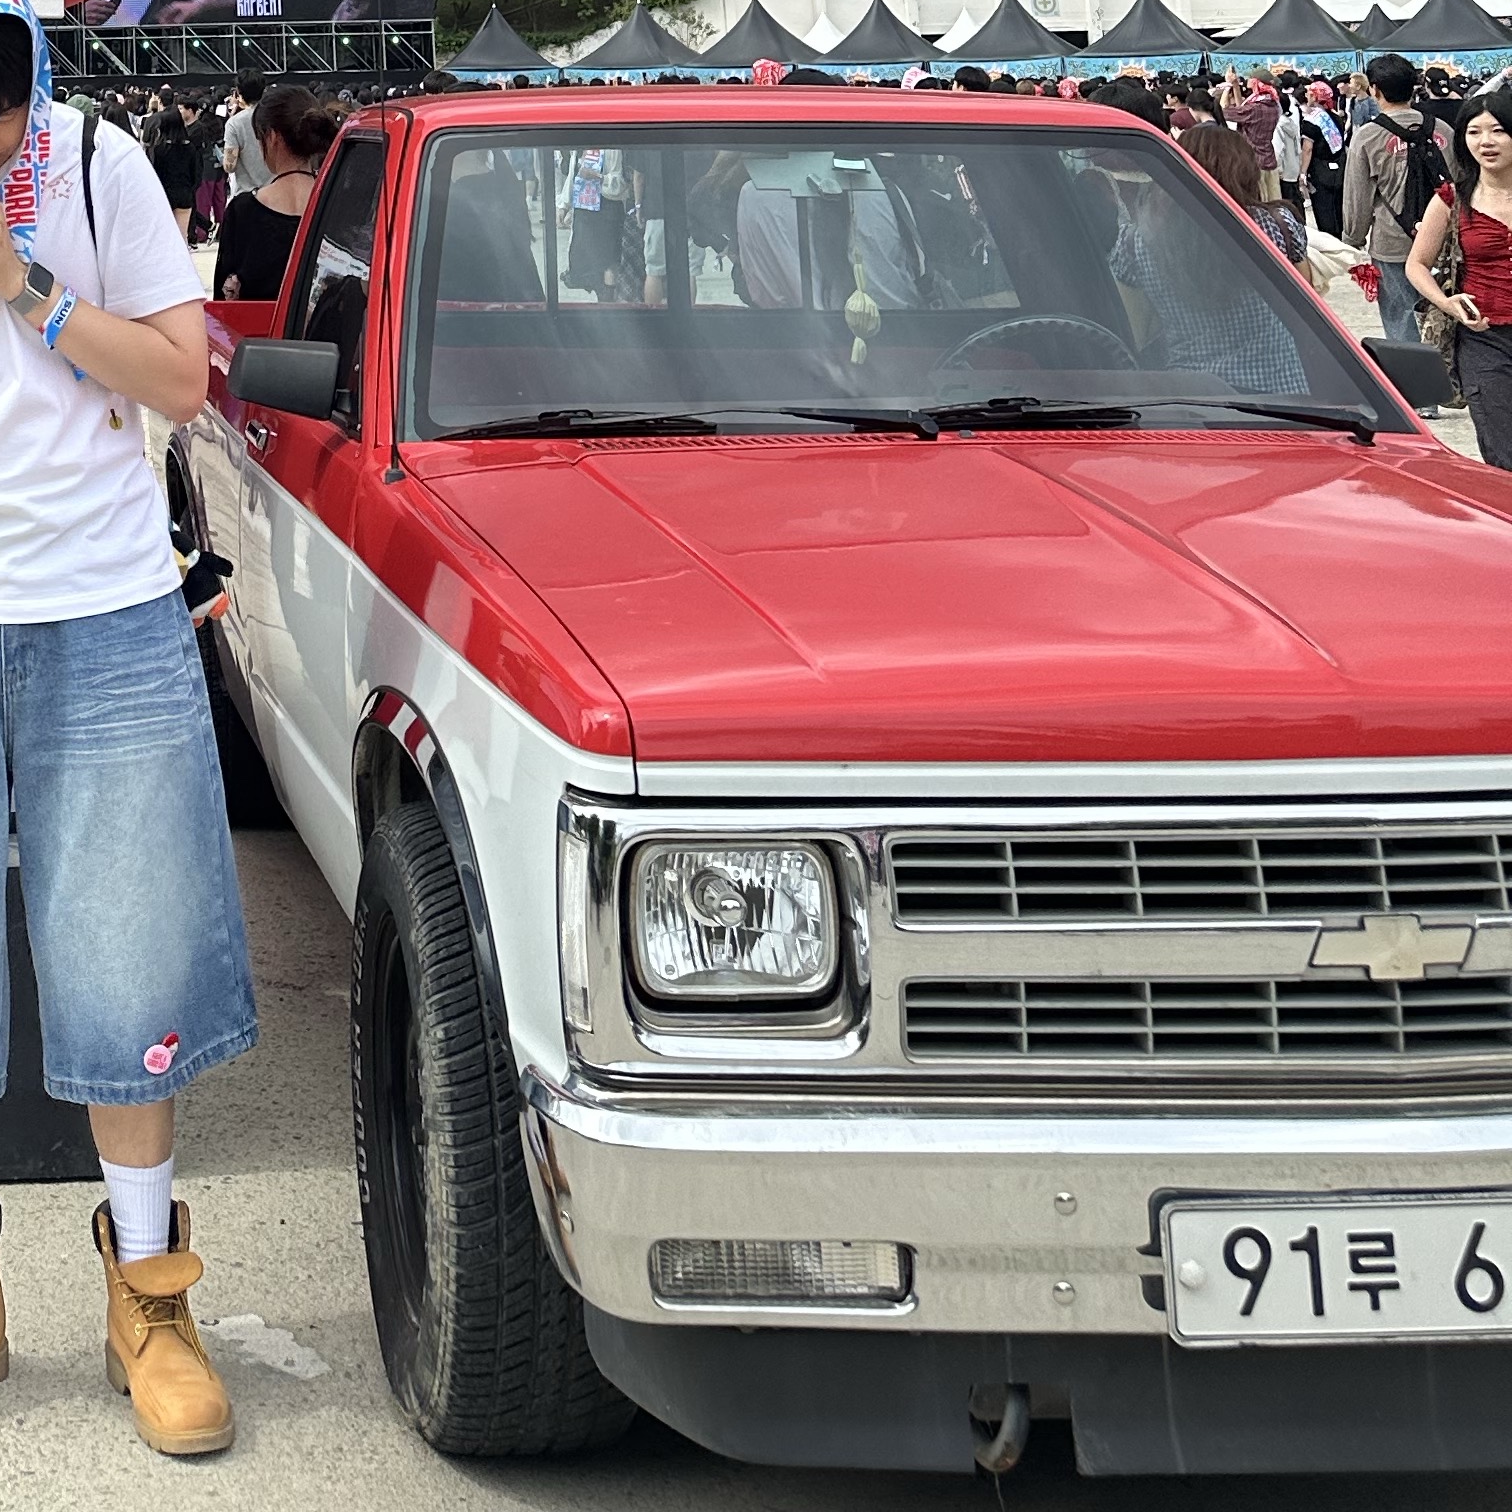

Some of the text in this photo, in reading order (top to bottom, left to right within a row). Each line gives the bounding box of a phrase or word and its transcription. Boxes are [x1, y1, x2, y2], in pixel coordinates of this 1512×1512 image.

[3, 168, 37, 228] PARK
[54, 300, 73, 326] SUN
[1222, 1224, 1401, 1317] 91루
